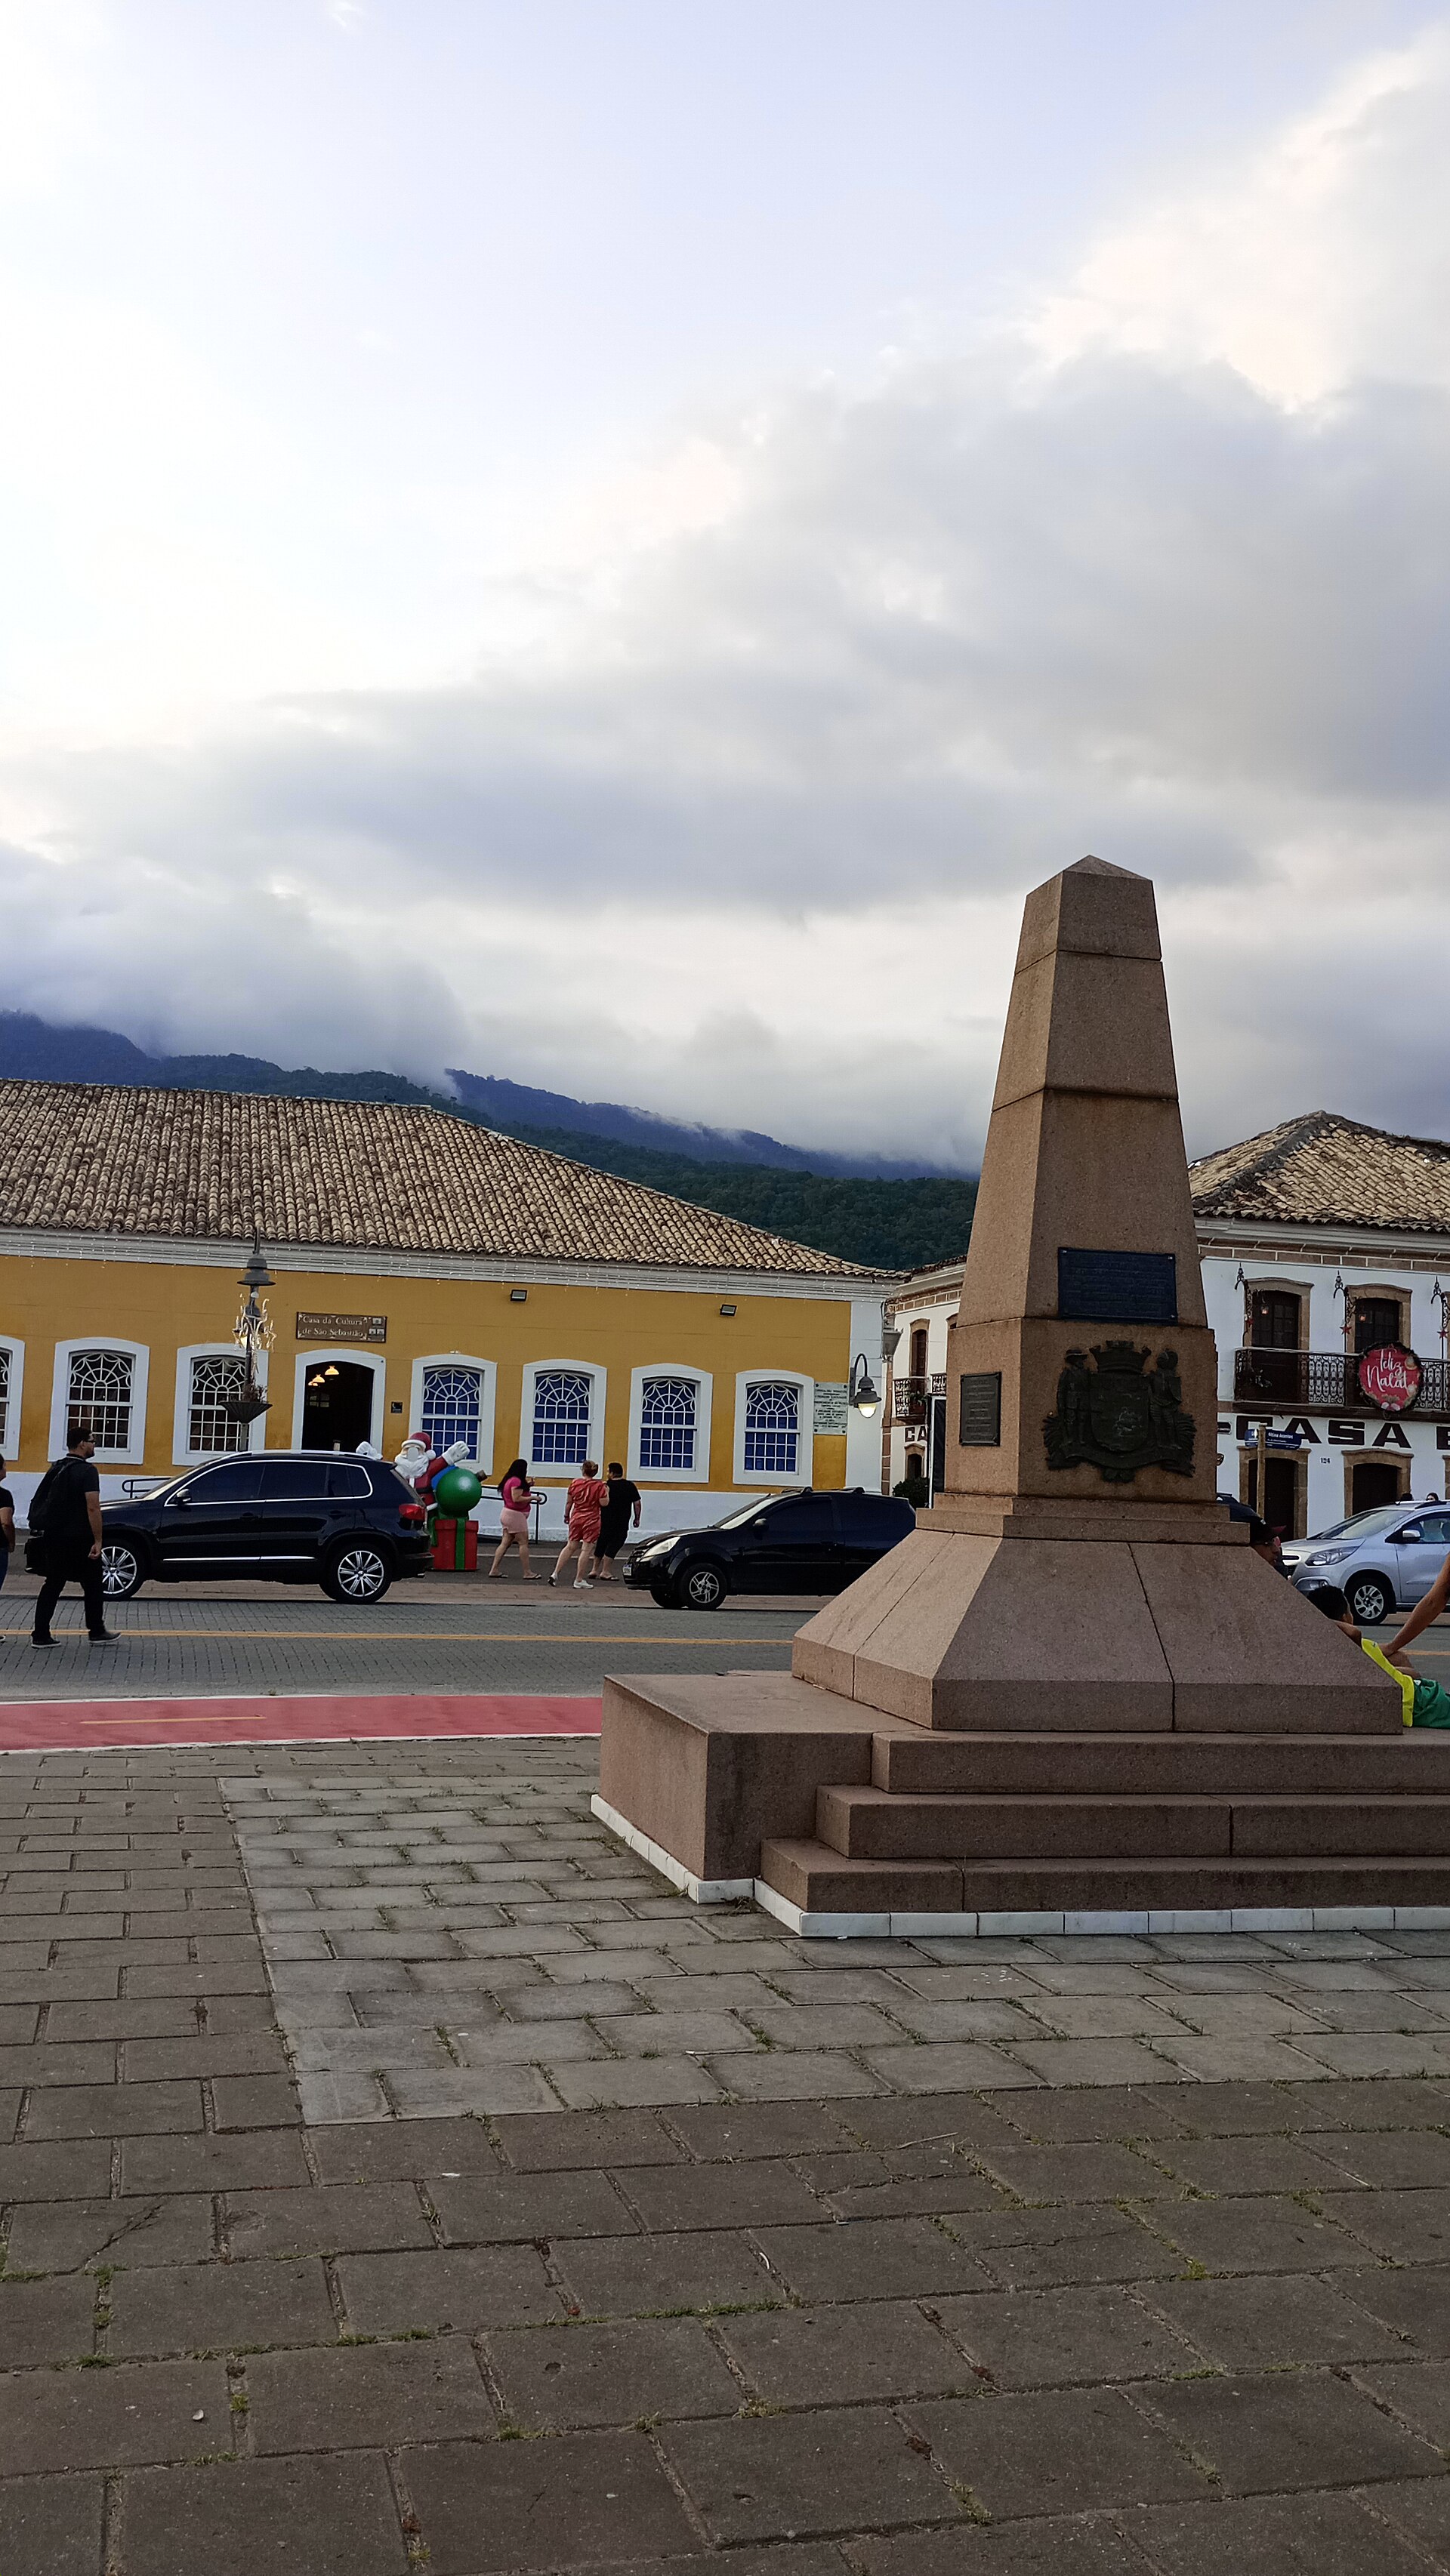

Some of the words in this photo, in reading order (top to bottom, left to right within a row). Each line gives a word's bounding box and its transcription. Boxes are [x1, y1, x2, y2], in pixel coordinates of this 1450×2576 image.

[303, 1315, 320, 1323] Casa
[335, 1317, 362, 1326] Cultura
[313, 1327, 327, 1336] São
[329, 1328, 363, 1337] Sebastião
[1374, 1346, 1404, 1376] Feliz
[1367, 1365, 1408, 1392] Natal
